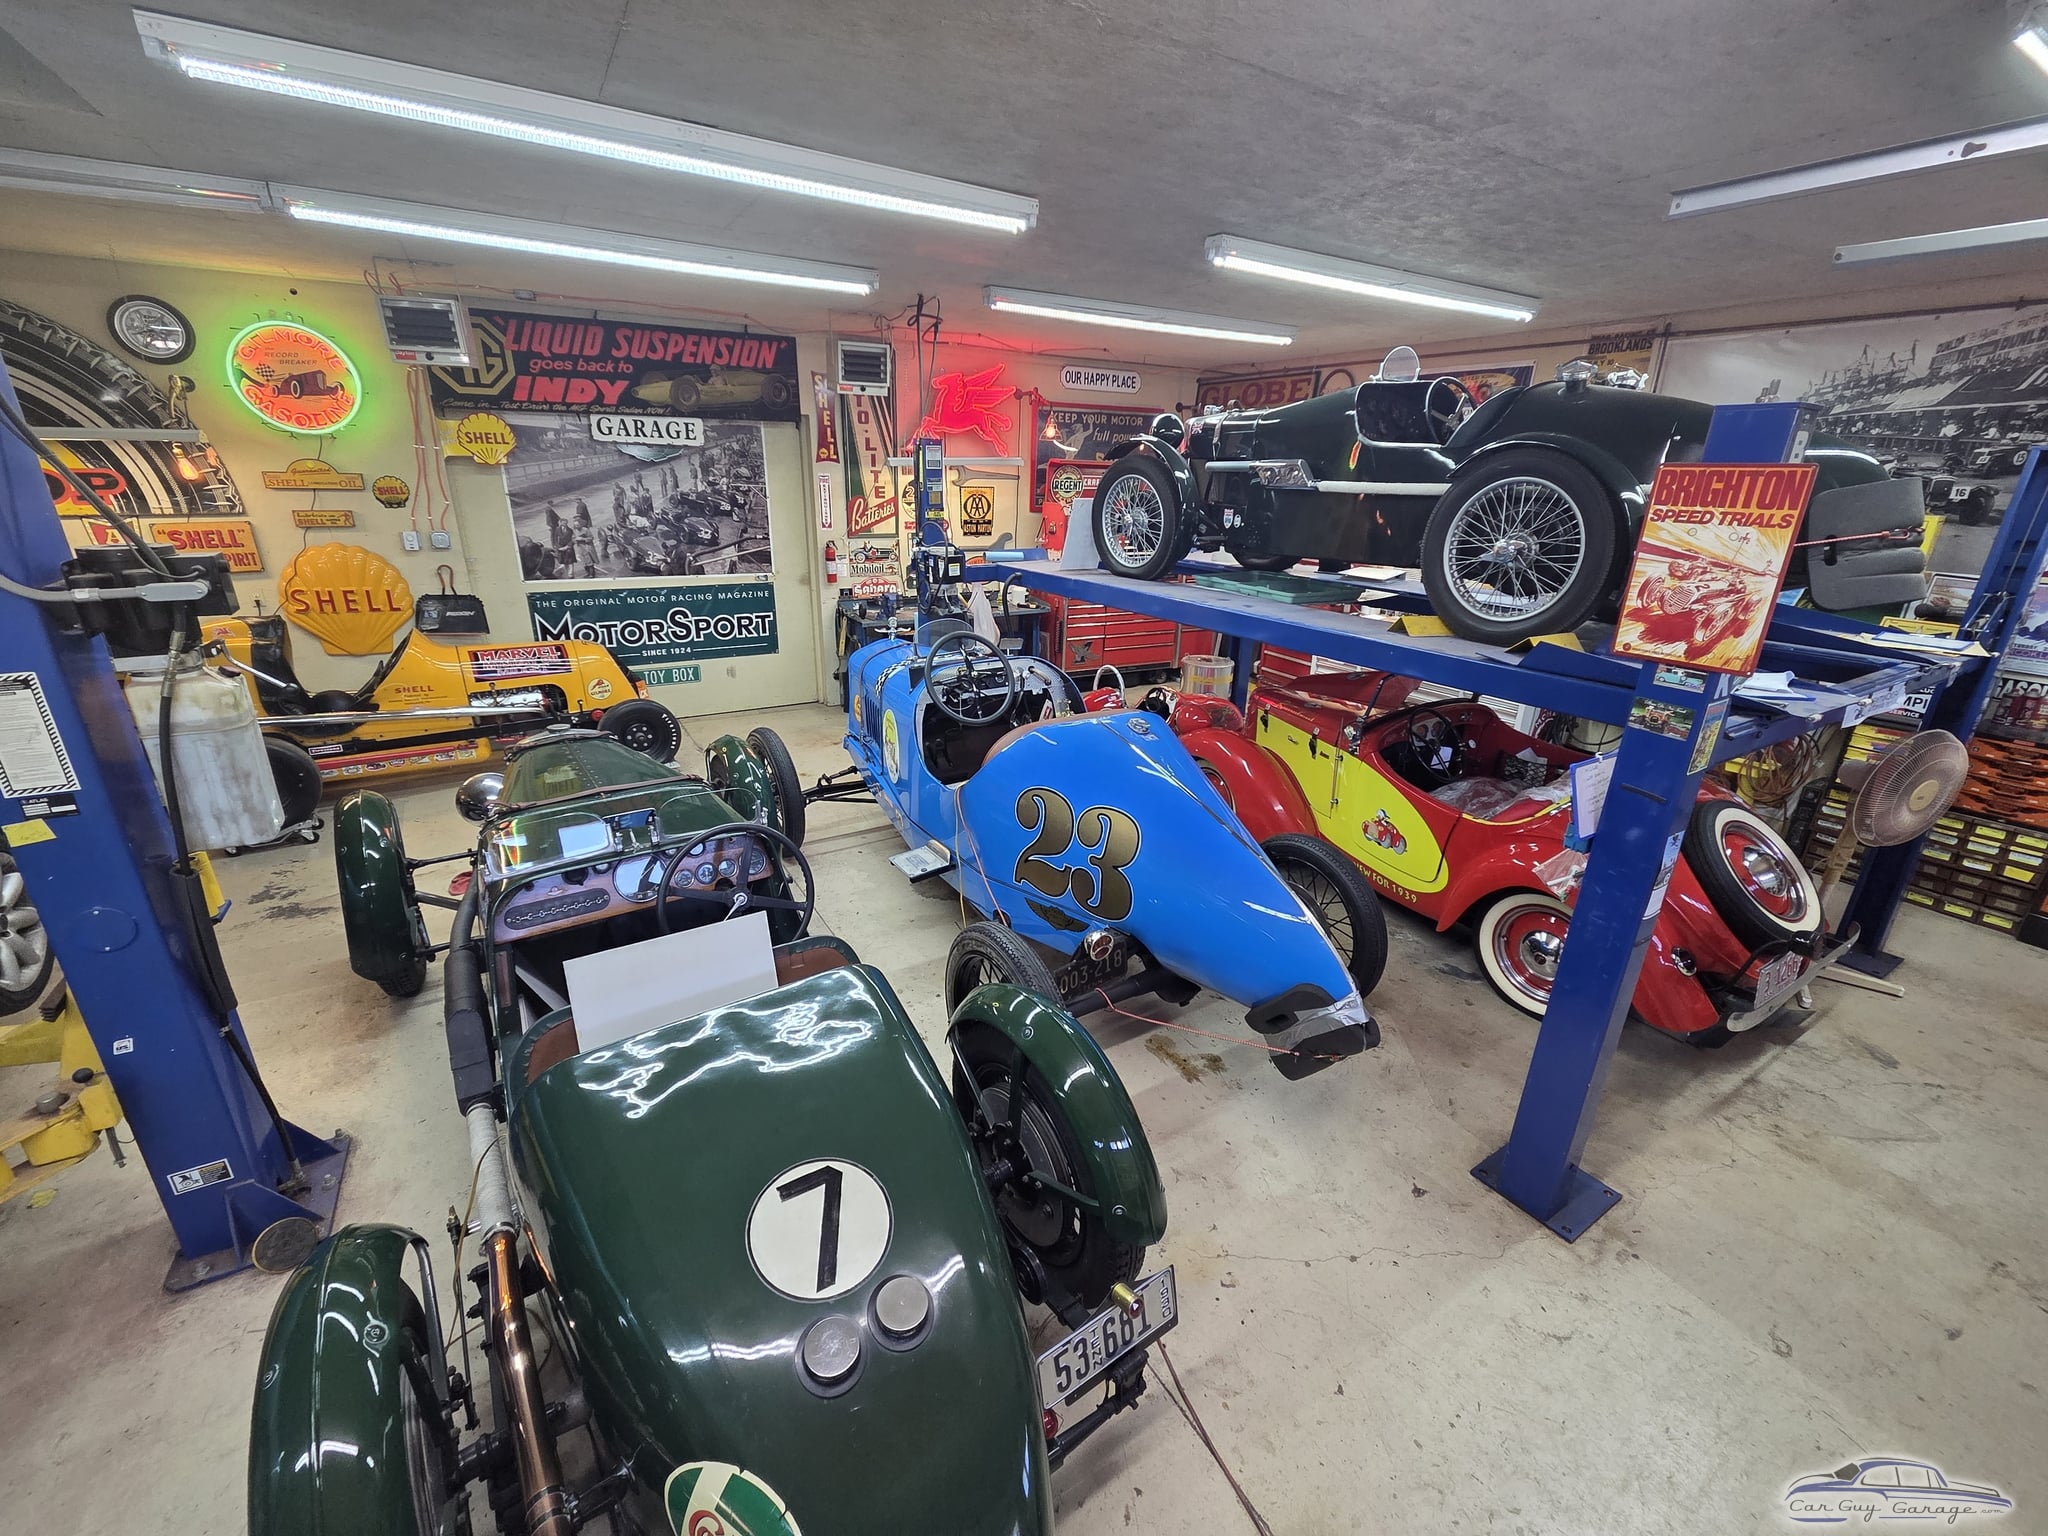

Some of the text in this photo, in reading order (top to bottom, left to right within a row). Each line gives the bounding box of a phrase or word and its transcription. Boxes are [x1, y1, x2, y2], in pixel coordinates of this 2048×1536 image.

[238, 328, 348, 370] GILMORE
[1587, 337, 1653, 355] BROOKLANDS
[529, 357, 633, 374] goes back to
[1064, 370, 1137, 389] OUR HAPPY PLACE
[512, 376, 630, 406] INDY
[1200, 377, 1313, 408] GLOBE
[243, 384, 355, 429] GASOLINE
[814, 374, 837, 459] SHELL
[1051, 413, 1144, 427] KEEP YOUR MOTOR
[596, 416, 697, 441] GARAGE
[1092, 427, 1110, 441] full
[464, 432, 510, 445] SHELL
[267, 478, 309, 488] SHELL
[338, 480, 362, 489] OIL
[376, 486, 406, 496] SHELL
[1053, 481, 1082, 491] REGENT
[1653, 469, 1809, 512] BRIGHTON
[1955, 488, 1968, 498] 16
[852, 498, 895, 532] Batteries
[1649, 508, 1796, 530] SPEED TRIALS
[851, 563, 885, 575] Mobiloil
[854, 583, 897, 595] Sahara
[289, 588, 404, 616] SHELL
[535, 590, 770, 609] THE ORIGINAL MOTOR RACING MAGAZINE
[480, 645, 561, 662] MARVEL
[642, 646, 692, 657] SINCE 1924
[644, 665, 695, 686] TOY BOX
[394, 685, 435, 694] SHELL
[1886, 708, 1921, 719] SERVICE
[1013, 786, 1142, 921] 23
[1372, 873, 1390, 889] FOR
[1392, 884, 1417, 903] 1939
[1053, 1290, 1152, 1394] 53 TENN 681
